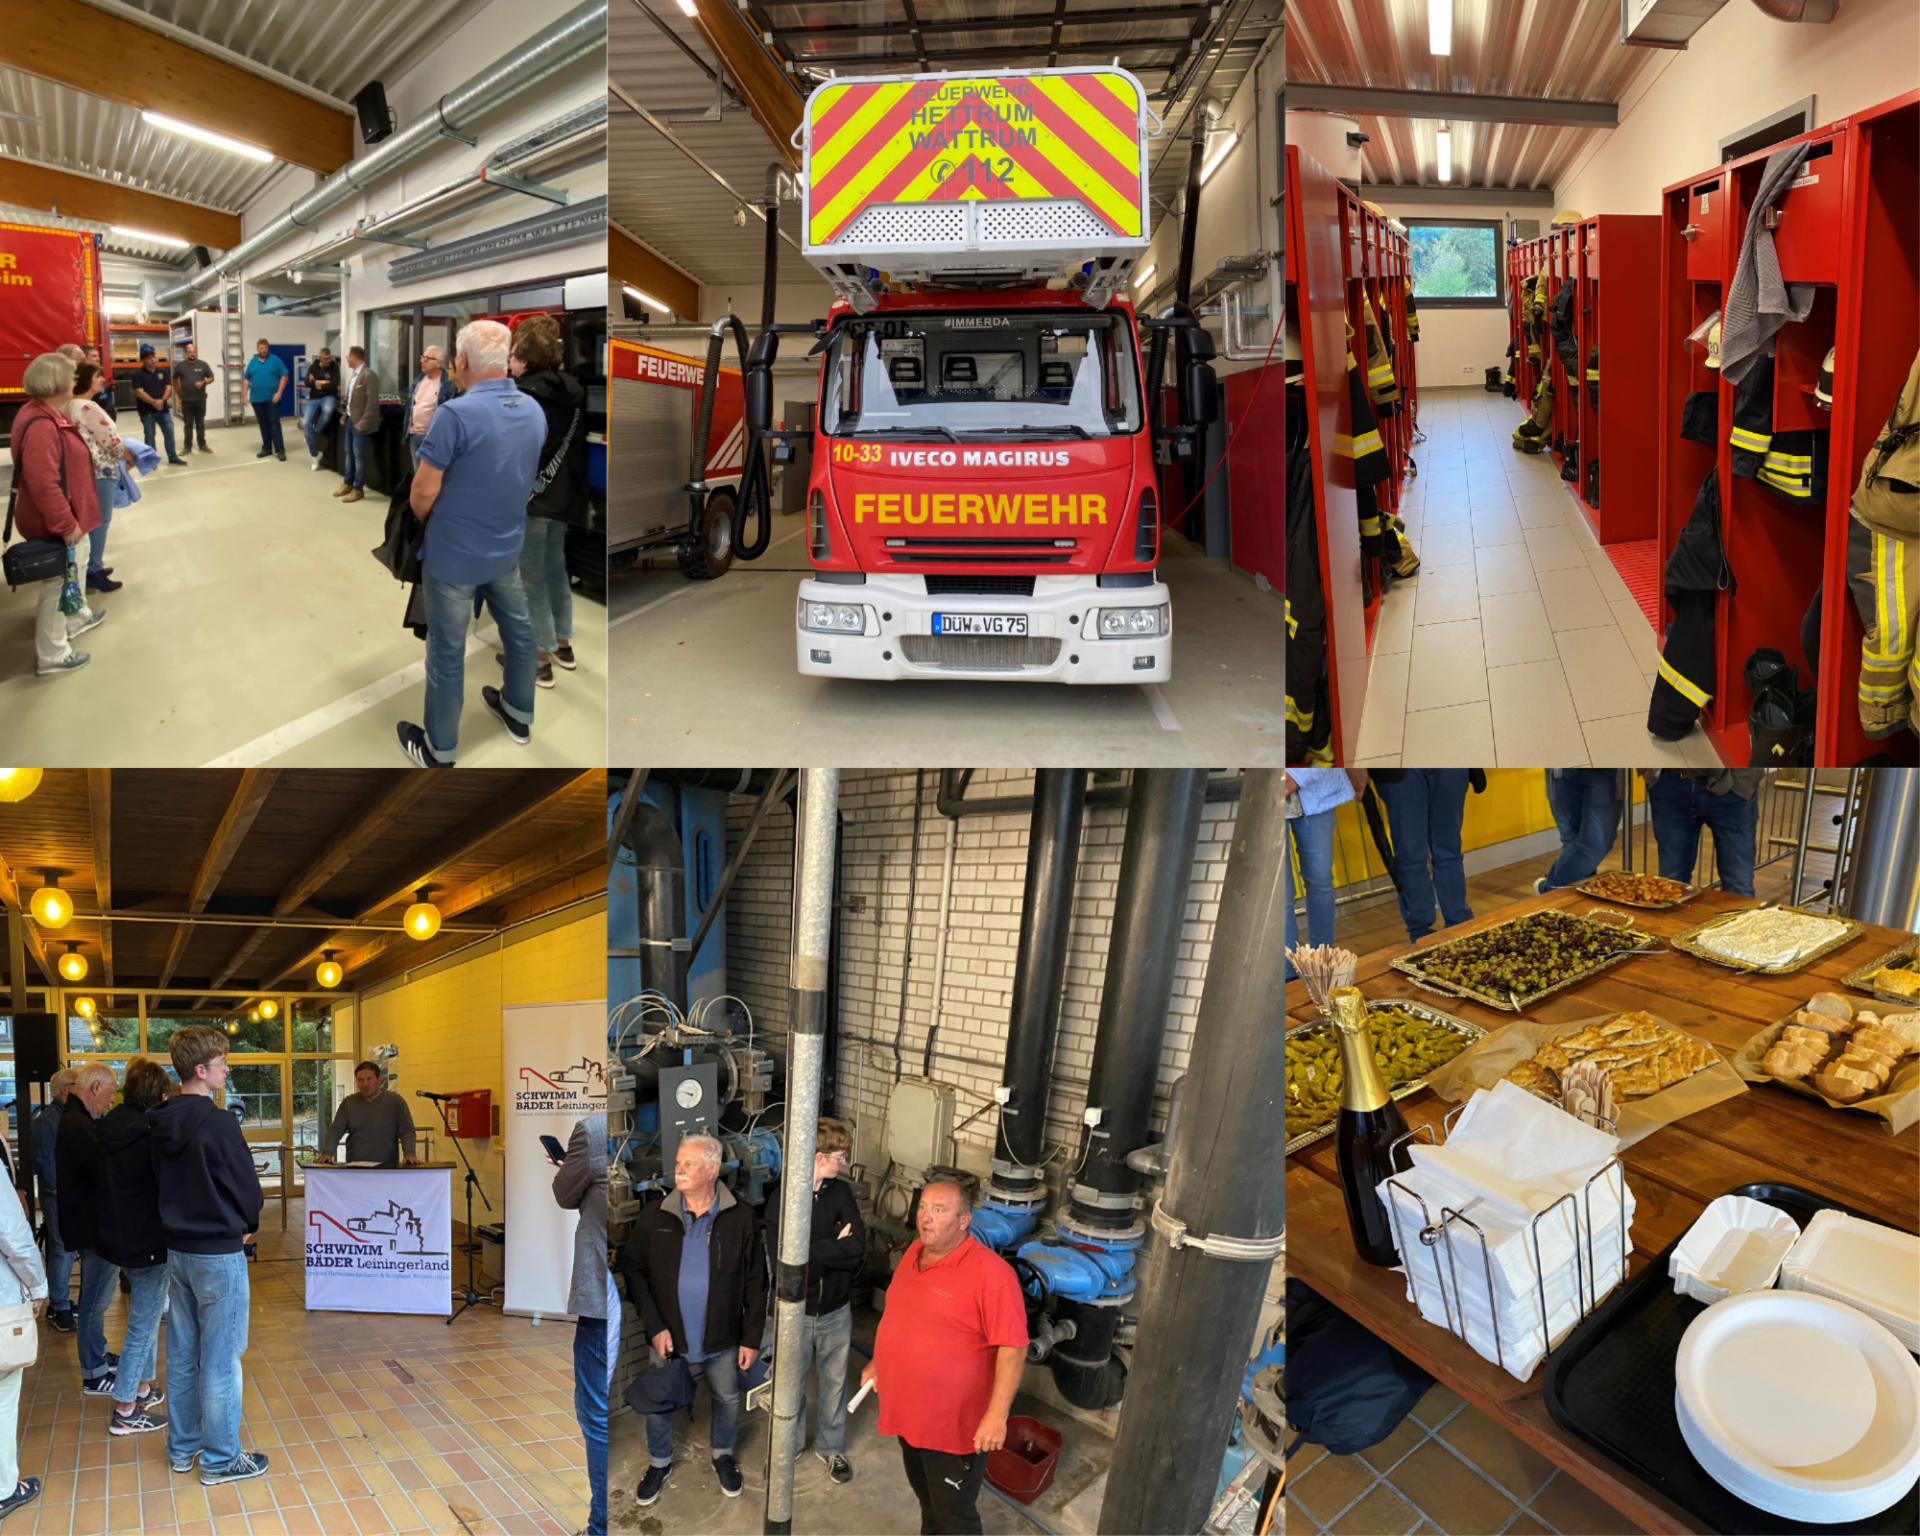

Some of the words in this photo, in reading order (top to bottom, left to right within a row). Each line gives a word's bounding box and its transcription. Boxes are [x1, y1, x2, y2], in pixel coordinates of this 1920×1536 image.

[913, 84, 1030, 102] FEUERWEHR
[911, 103, 1033, 125] HETTRUM
[909, 127, 1037, 150] WATTRUM
[962, 157, 1015, 183] 112
[0, 270, 32, 286] im
[944, 317, 1010, 329] #IMMERDA
[637, 354, 719, 388] FEUERWE
[833, 444, 882, 462] 10-33
[890, 451, 957, 467] IVECO
[963, 451, 1070, 466] MAGIRUS
[855, 494, 1107, 524] FEUERWEHR
[983, 617, 1003, 633] VG
[1006, 617, 1026, 633] 75
[516, 1091, 577, 1100] SCHWIMM
[516, 1100, 554, 1110] BÄDER
[556, 1101, 607, 1111] Leininger
[306, 1243, 383, 1255] SCHWIMM
[306, 1253, 353, 1268] BÄDER
[357, 1258, 450, 1272] Leiningerland
